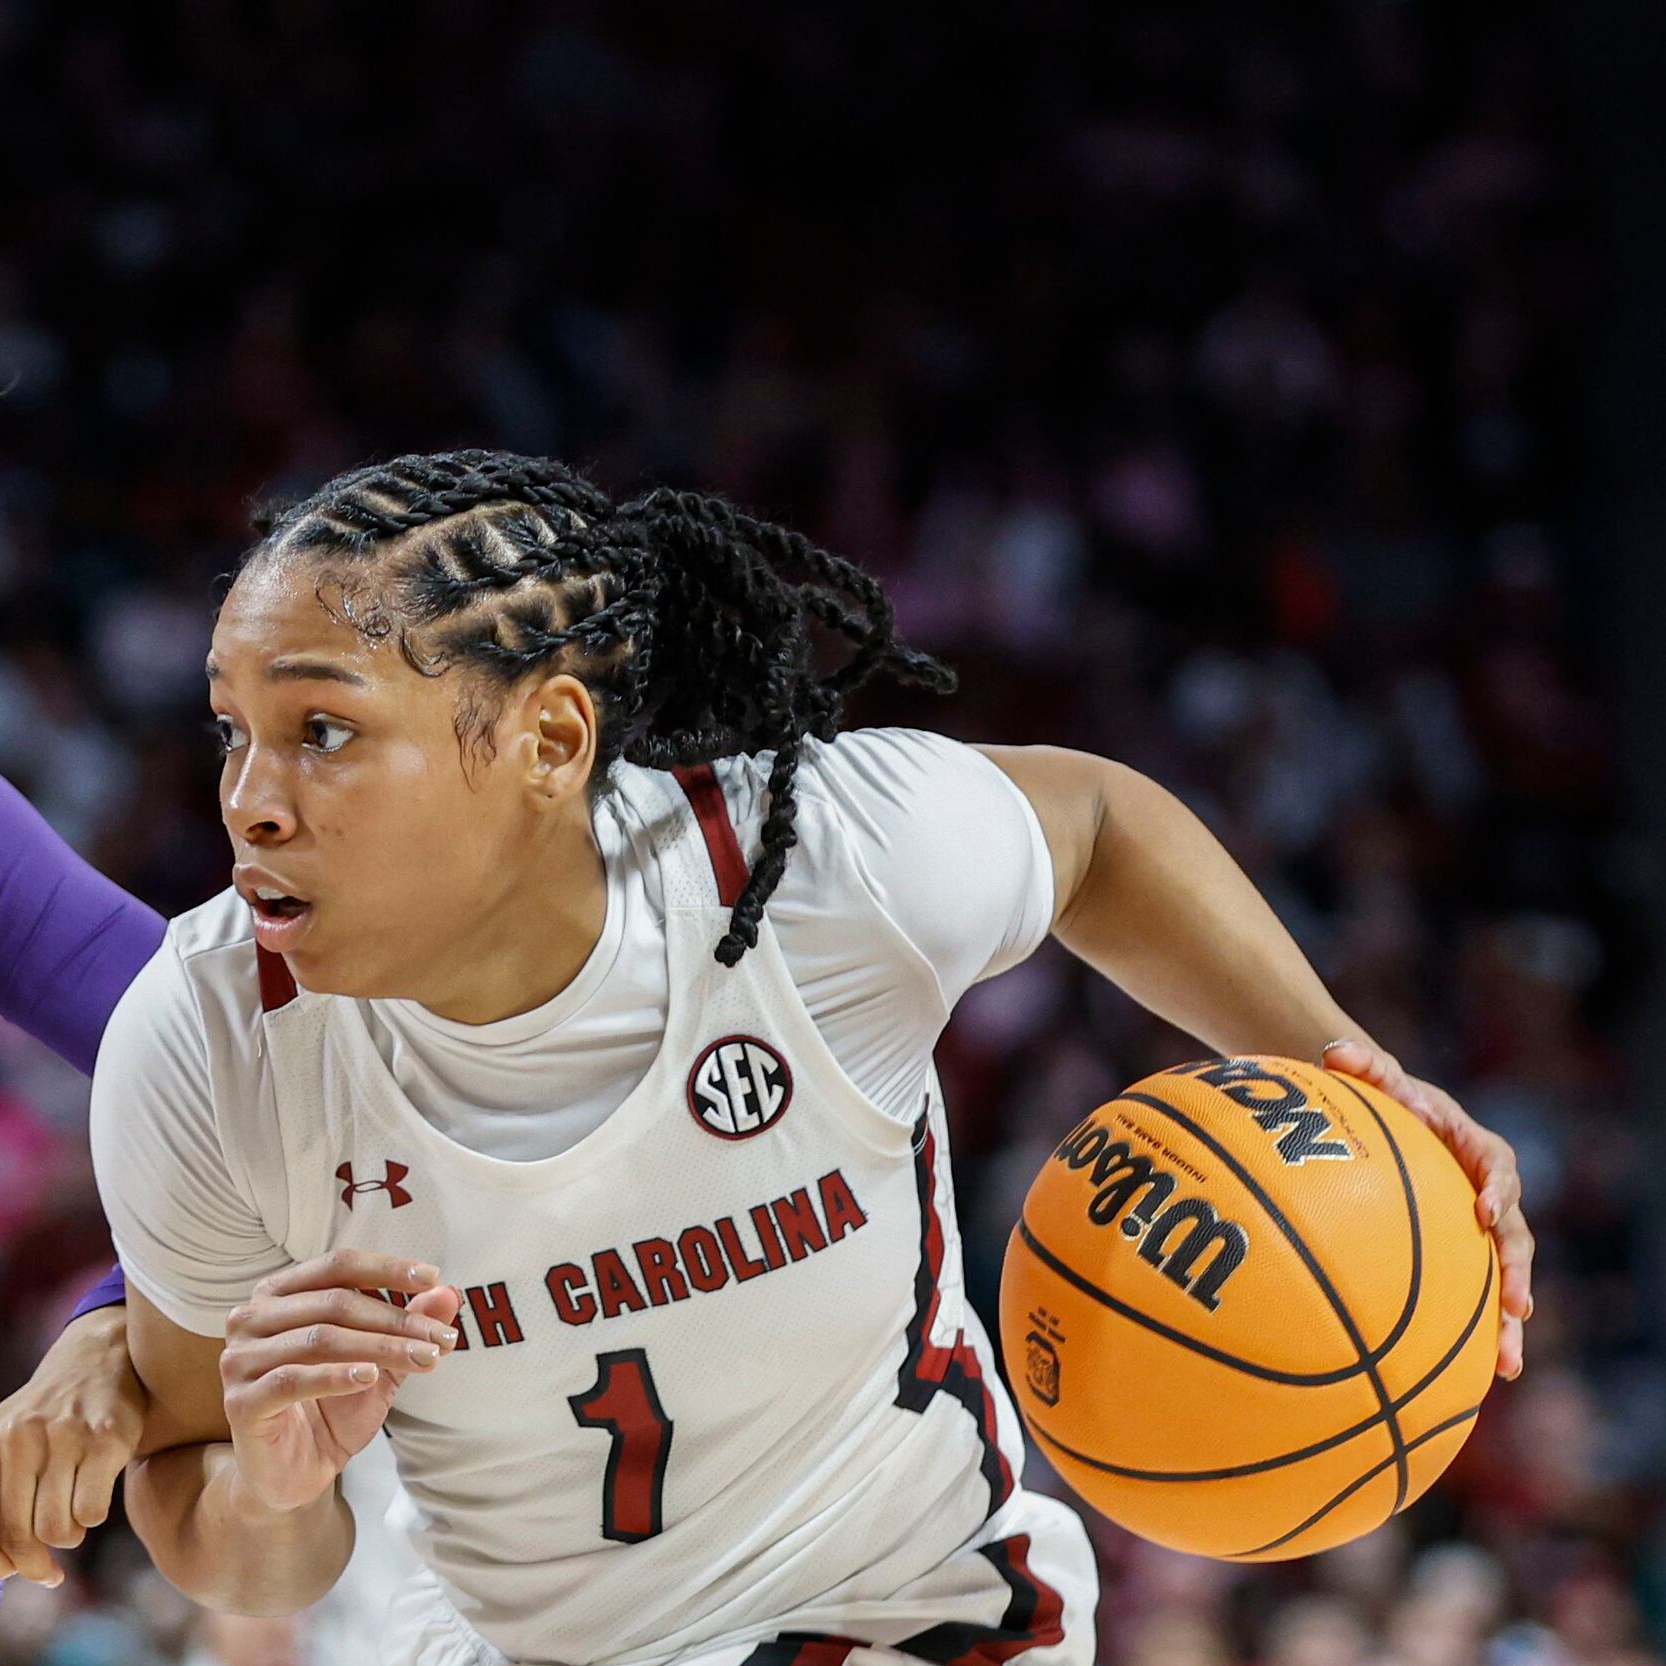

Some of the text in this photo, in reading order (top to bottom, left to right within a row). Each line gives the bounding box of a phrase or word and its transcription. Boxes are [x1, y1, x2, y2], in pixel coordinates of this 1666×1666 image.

[693, 1041, 787, 1134] SEC
[1161, 1147, 1207, 1183] INDOOR
[544, 1168, 869, 1327] CAROLINA
[567, 1348, 674, 1544] 1
